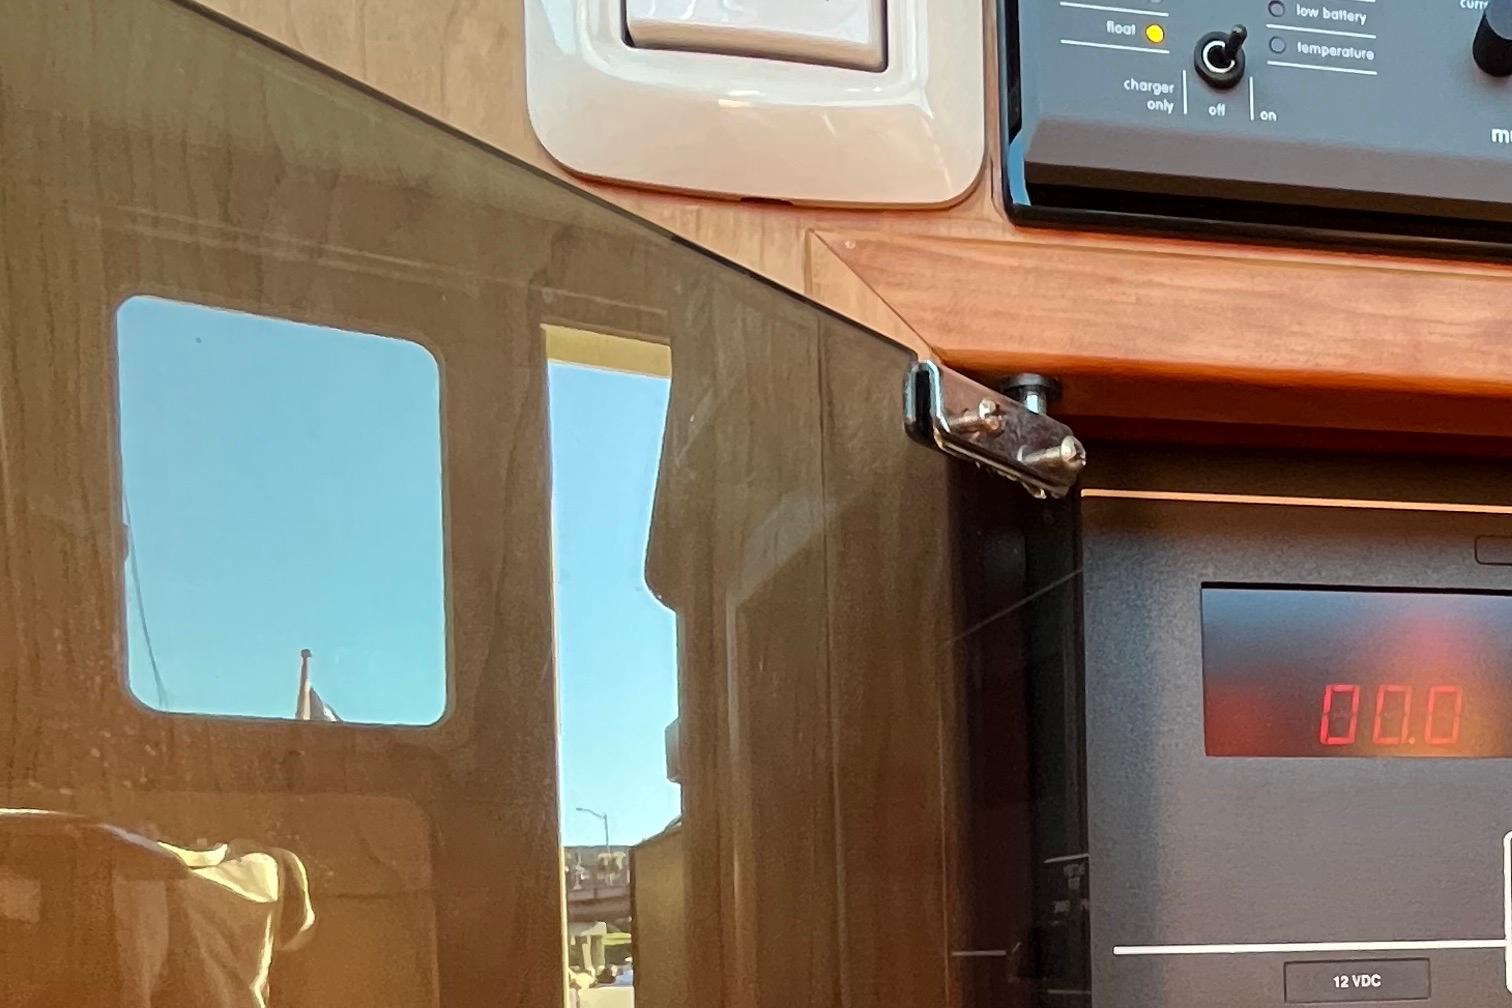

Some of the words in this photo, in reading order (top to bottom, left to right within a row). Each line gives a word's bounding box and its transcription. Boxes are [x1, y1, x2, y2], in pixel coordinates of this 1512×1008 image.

[1296, 4, 1319, 19] low
[1322, 5, 1367, 25] battery
[1106, 20, 1136, 36] float
[1297, 41, 1375, 61] temperature
[1123, 78, 1175, 95] charger
[1147, 98, 1174, 114] only
[1208, 103, 1226, 116] off
[1260, 110, 1277, 122] on
[1320, 684, 1463, 745] 00.0
[1333, 975, 1349, 988] 12
[1352, 974, 1381, 987] VDC
